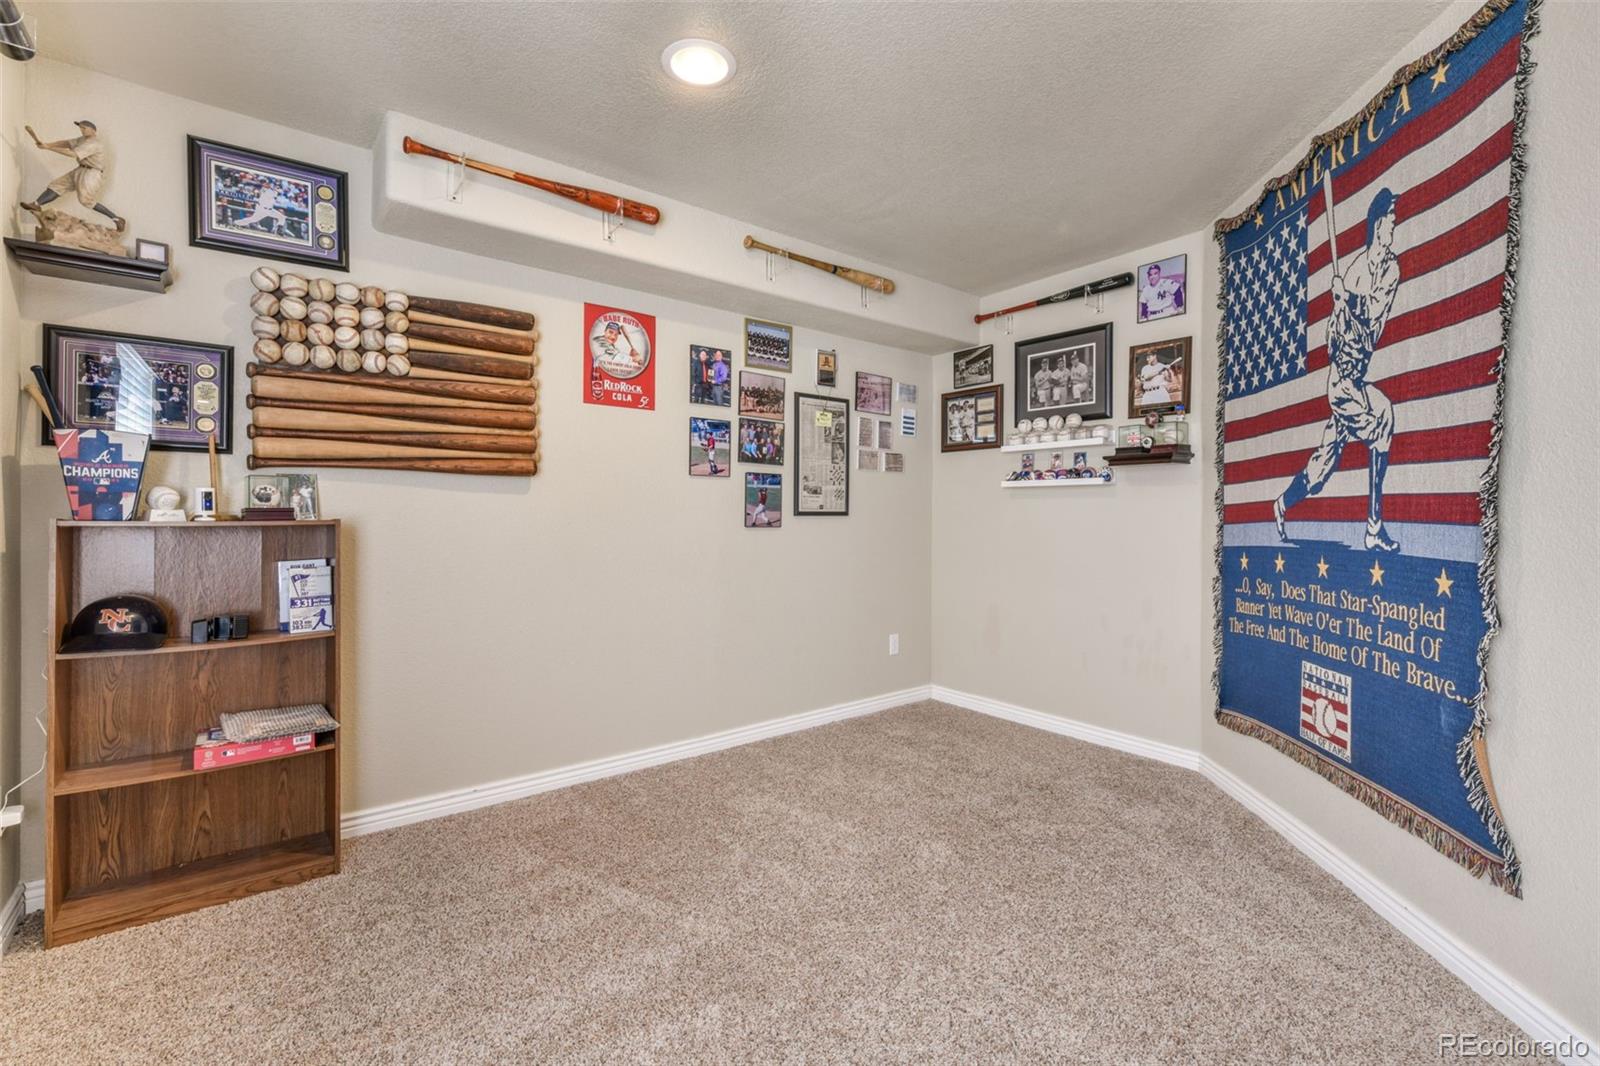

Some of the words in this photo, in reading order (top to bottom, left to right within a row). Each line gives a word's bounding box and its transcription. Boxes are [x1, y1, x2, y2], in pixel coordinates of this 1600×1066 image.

[1273, 84, 1413, 217] AMERICA
[612, 392, 633, 402] COLA
[63, 464, 139, 480] CHAMPIONS
[1235, 597, 1265, 616] Banner
[1268, 602, 1282, 620] Yet
[1285, 604, 1313, 627] Wave
[1316, 611, 1343, 635] O'er
[1346, 617, 1373, 642] The
[1377, 624, 1415, 654] Land
[1420, 636, 1443, 662] Of
[1256, 578, 1275, 599] Say,
[1281, 580, 1306, 601] Does
[1309, 584, 1336, 607] That
[1340, 589, 1446, 631] Star-Spangled
[1228, 616, 1244, 634] The
[1246, 619, 1265, 638] Free
[1267, 623, 1286, 643] And
[1289, 628, 1310, 650] The
[1312, 634, 1347, 662] Home
[1351, 646, 1369, 668] Of
[1372, 650, 1400, 679] The
